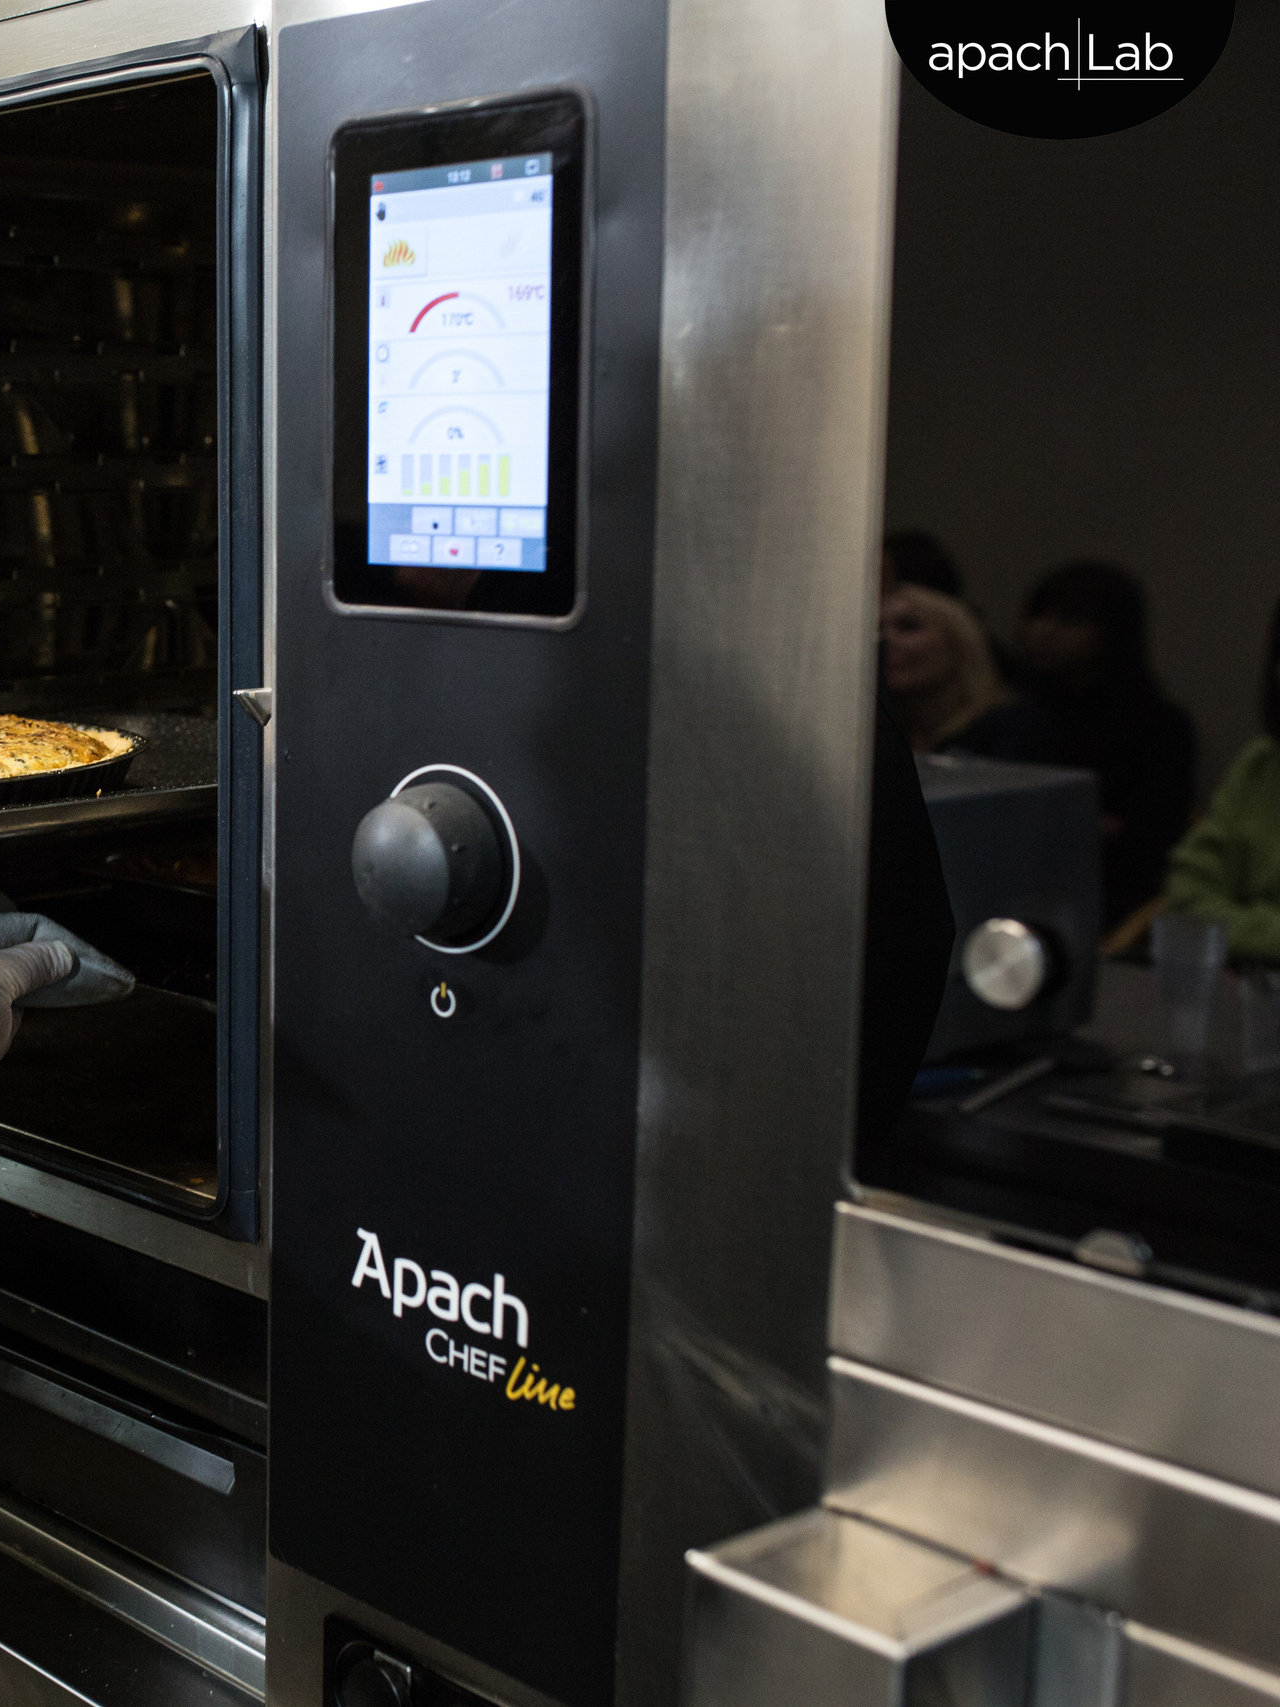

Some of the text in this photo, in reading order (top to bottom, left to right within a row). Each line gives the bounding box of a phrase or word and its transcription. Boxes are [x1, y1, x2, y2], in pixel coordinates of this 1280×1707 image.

[351, 1227, 529, 1349] Apach
[425, 1327, 576, 1411] CHEF line
